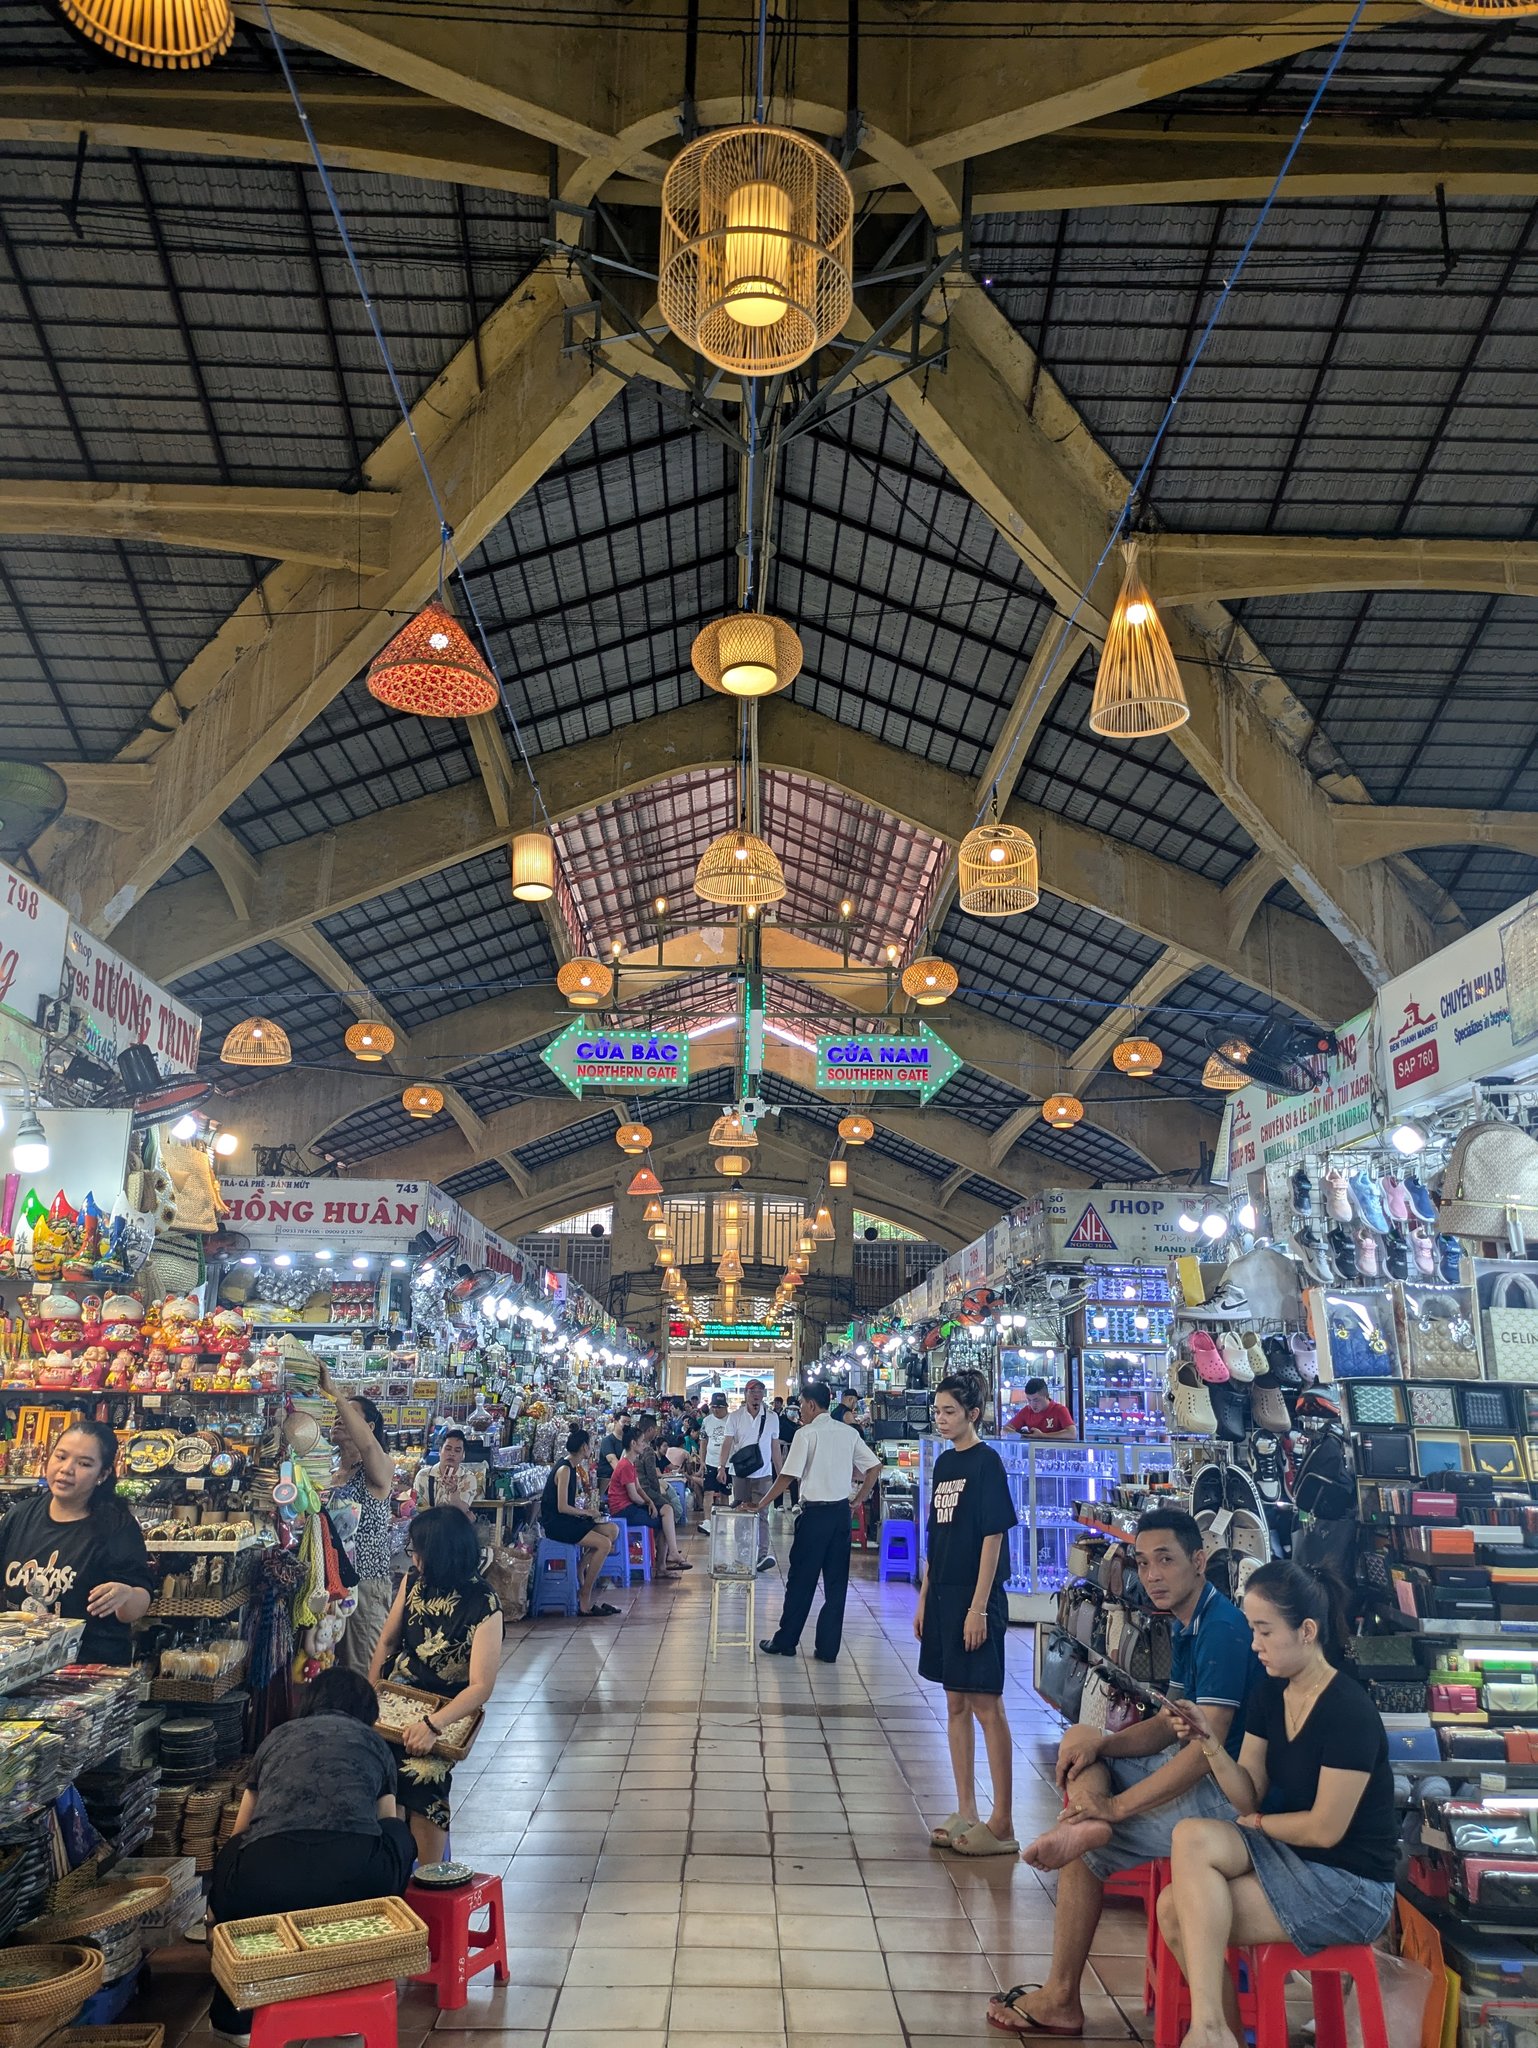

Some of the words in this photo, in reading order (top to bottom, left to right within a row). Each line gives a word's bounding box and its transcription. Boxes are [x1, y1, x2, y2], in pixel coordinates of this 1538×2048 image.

[7, 874, 39, 920] 798
[73, 931, 92, 967] Shop
[92, 958, 152, 1046] HƯƠNG
[1440, 979, 1474, 1019] CHUYÊN
[1473, 972, 1494, 1002] MUA
[1389, 1042, 1400, 1053] BEN
[1400, 1034, 1416, 1048] THANH
[1416, 1022, 1438, 1040] MARKET
[1454, 1018, 1483, 1046] Specializes
[1482, 1014, 1490, 1029] in
[576, 1038, 624, 1060] CỬA
[632, 1038, 678, 1061] BẮC
[828, 1042, 876, 1064] CỬA
[880, 1047, 928, 1063] NAM
[1418, 1048, 1434, 1069] 760
[577, 1064, 644, 1079] NORTHERN
[646, 1066, 678, 1080] GATE
[828, 1068, 894, 1081] SOUTHERN
[896, 1068, 928, 1081] GATE
[1260, 1116, 1284, 1144] CHUYÊN
[1293, 1110, 1298, 1127] &
[1338, 1081, 1349, 1107] TÚI
[1350, 1074, 1370, 1100] XÁCH
[1244, 1141, 1256, 1163] 758
[396, 1184, 418, 1194] 743
[220, 1188, 314, 1222] HỒNG
[322, 1196, 418, 1226] HUÂN
[1107, 1199, 1164, 1215] SHOP
[1080, 1214, 1103, 1241] NH
[1154, 1222, 1174, 1232] TÚI
[1154, 1245, 1186, 1253] HAND
[934, 1478, 966, 1494] AMAZING
[934, 1492, 959, 1508] GOOD
[936, 1507, 954, 1524] DAY
[468, 1890, 483, 1910] 758
